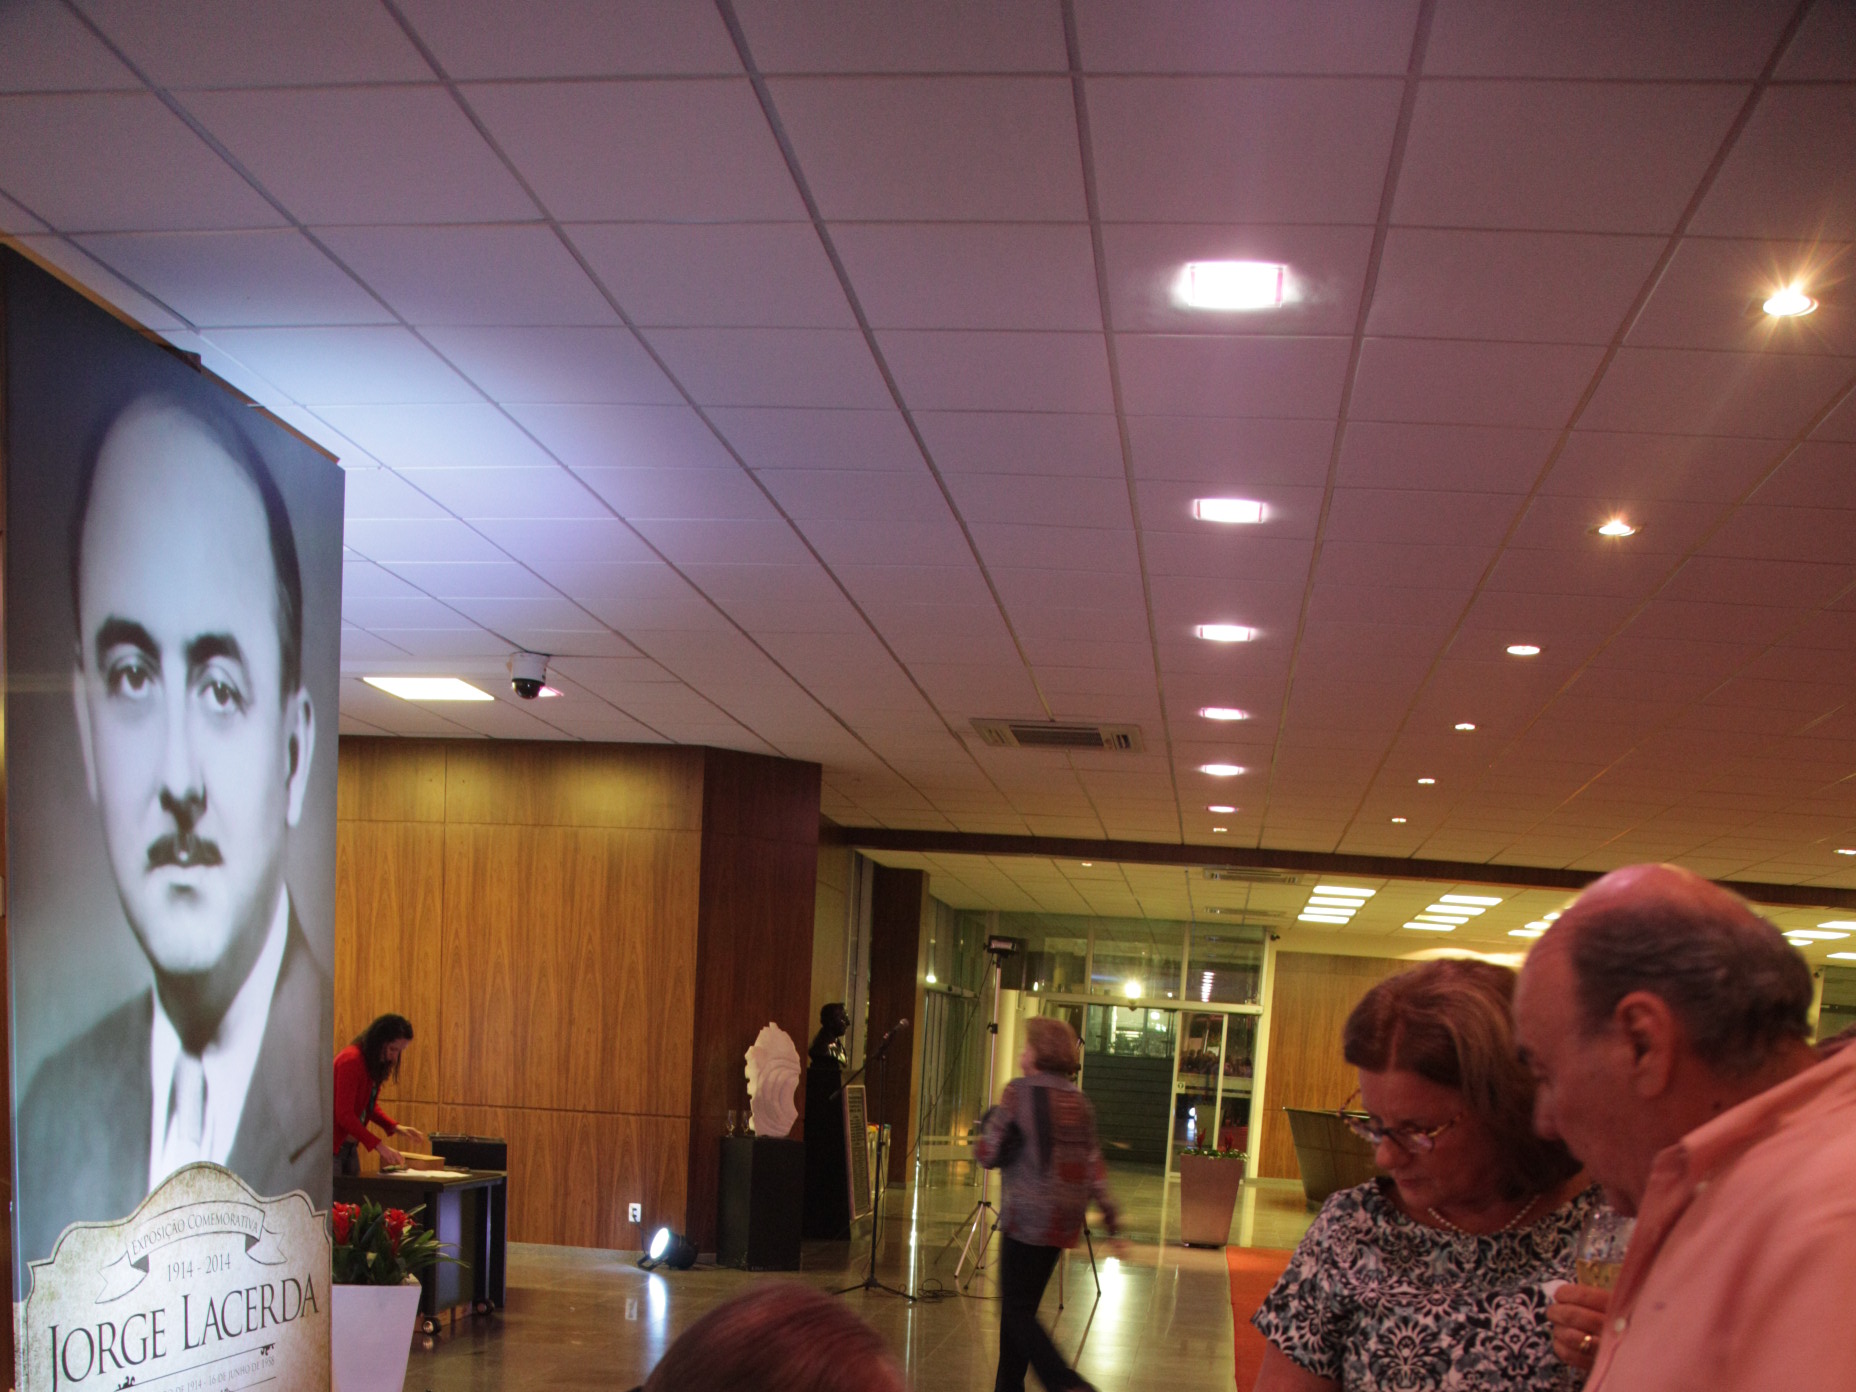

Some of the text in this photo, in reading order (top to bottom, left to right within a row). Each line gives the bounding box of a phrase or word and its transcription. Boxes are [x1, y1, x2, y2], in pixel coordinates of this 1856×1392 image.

[131, 1212, 258, 1255] EXPOSIÇÃO COMEMORATIVA
[168, 1260, 194, 1282] 1914
[205, 1252, 231, 1274] 2014
[181, 1273, 320, 1351] LACERDA
[187, 1379, 202, 1392] 1914
[208, 1375, 216, 1386] 16
[217, 1371, 226, 1383] DE
[228, 1364, 251, 1380] JUNHO
[251, 1361, 260, 1372] DE
